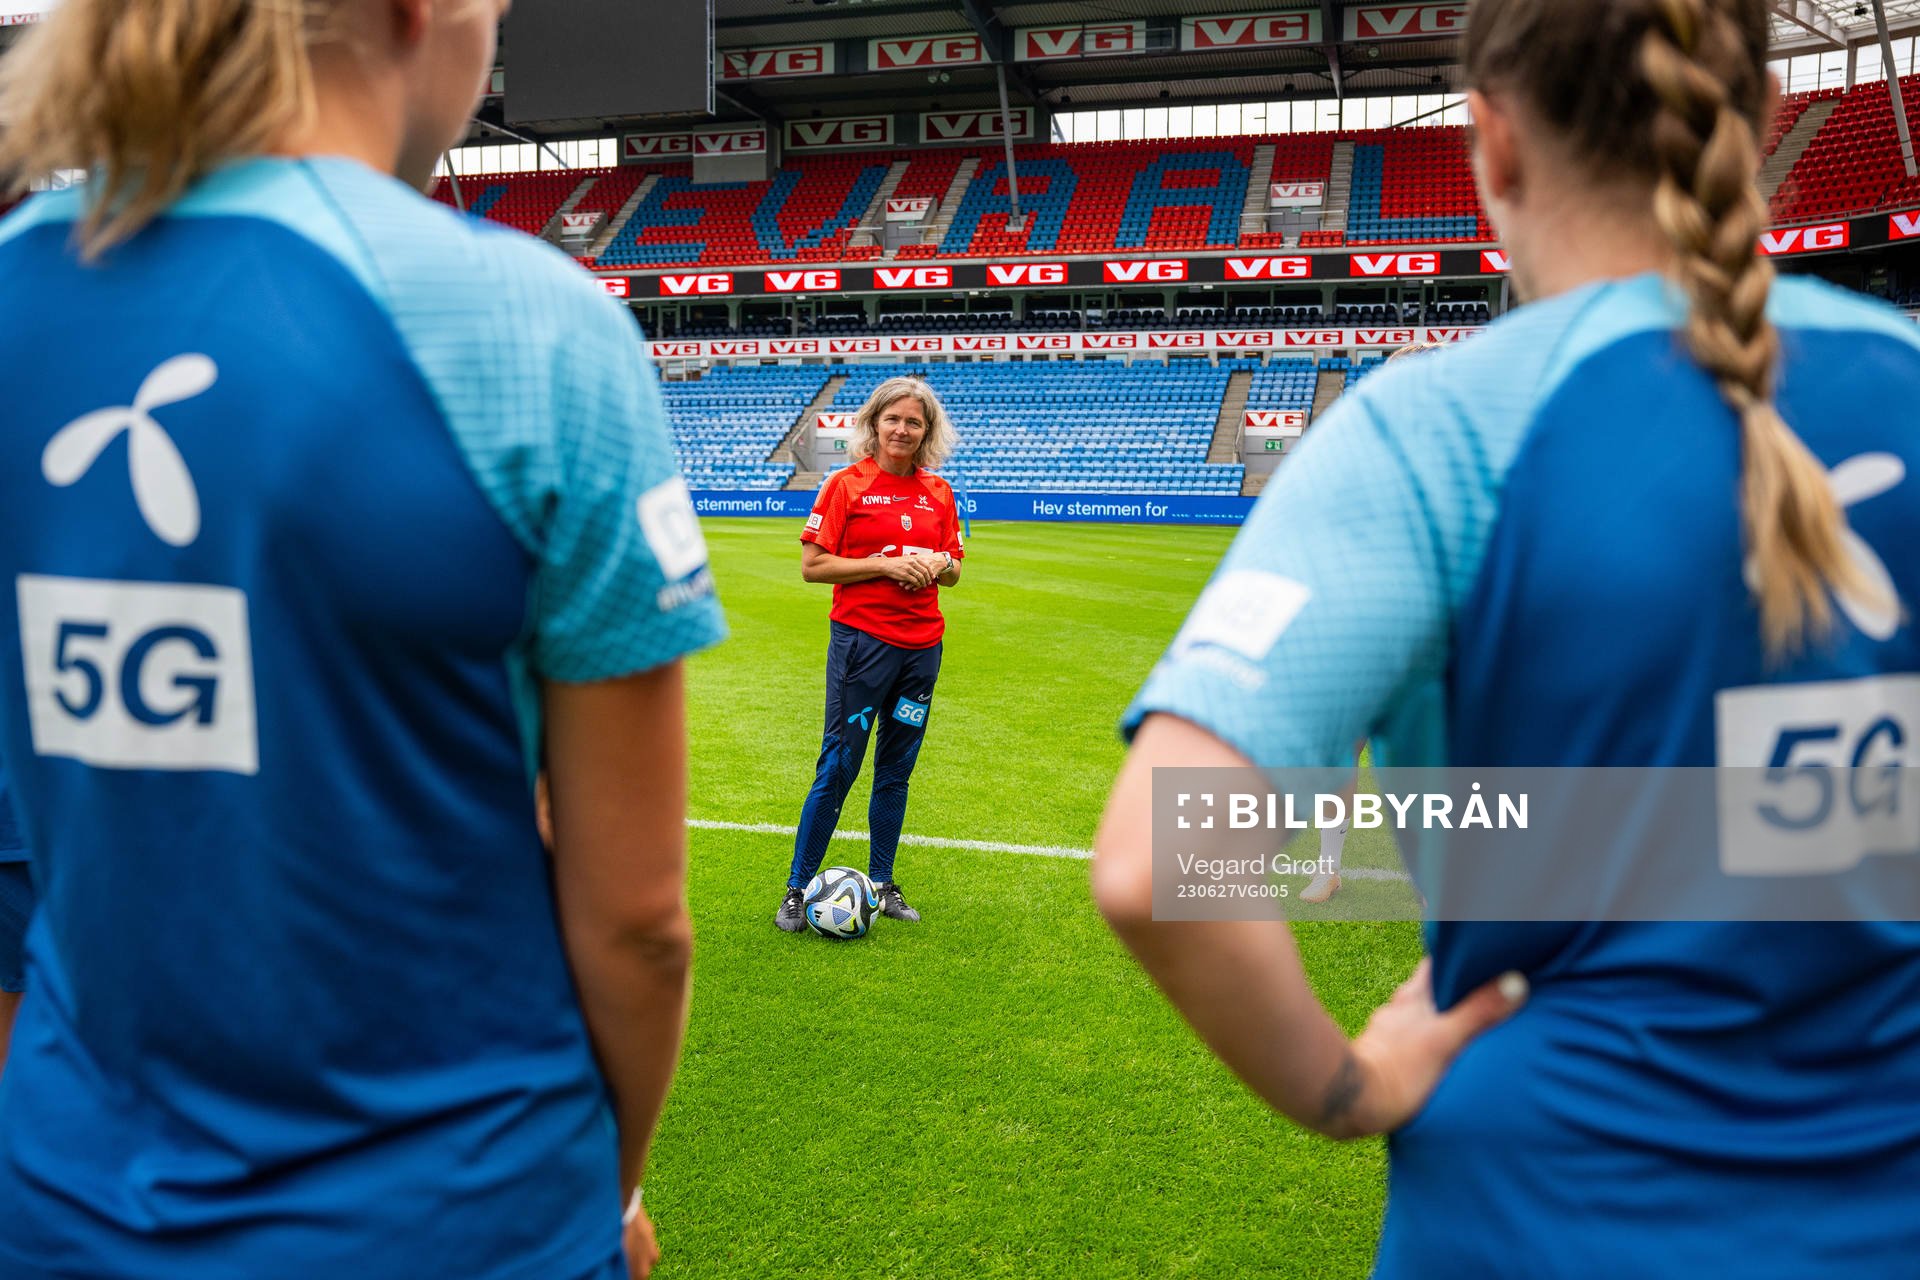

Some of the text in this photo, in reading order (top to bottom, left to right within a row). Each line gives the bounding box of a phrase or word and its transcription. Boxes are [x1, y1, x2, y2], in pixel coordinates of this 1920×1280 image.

[724, 5, 1467, 77] VG VG VG VG VG
[630, 111, 1023, 155] VG VG VG VG
[1275, 183, 1323, 197] VG
[888, 200, 929, 212] VG
[564, 215, 600, 226] VG
[1759, 213, 1920, 254] VG V
[596, 252, 1512, 296] G VG VG VG VG VG VG VG V
[655, 344, 697, 355] VG
[713, 343, 756, 354] VG
[771, 342, 816, 353] VG
[832, 341, 877, 351] VG
[893, 339, 939, 350] VG
[955, 338, 1003, 349] VG
[1019, 337, 1067, 348] VG
[1084, 336, 1133, 347] VG
[1150, 334, 1201, 346] VG
[1218, 333, 1270, 345] VG
[1287, 332, 1340, 344] VG
[1357, 331, 1411, 343] VG
[1247, 413, 1303, 427] VG
[697, 498, 762, 511] stemmen
[766, 497, 786, 511] for
[862, 495, 882, 505] KIWI
[955, 499, 977, 512] NB
[1033, 501, 1169, 517] Hev stemmen for
[55, 620, 219, 728] 5G
[897, 704, 924, 723] 5G
[1757, 715, 1904, 831] 5G
